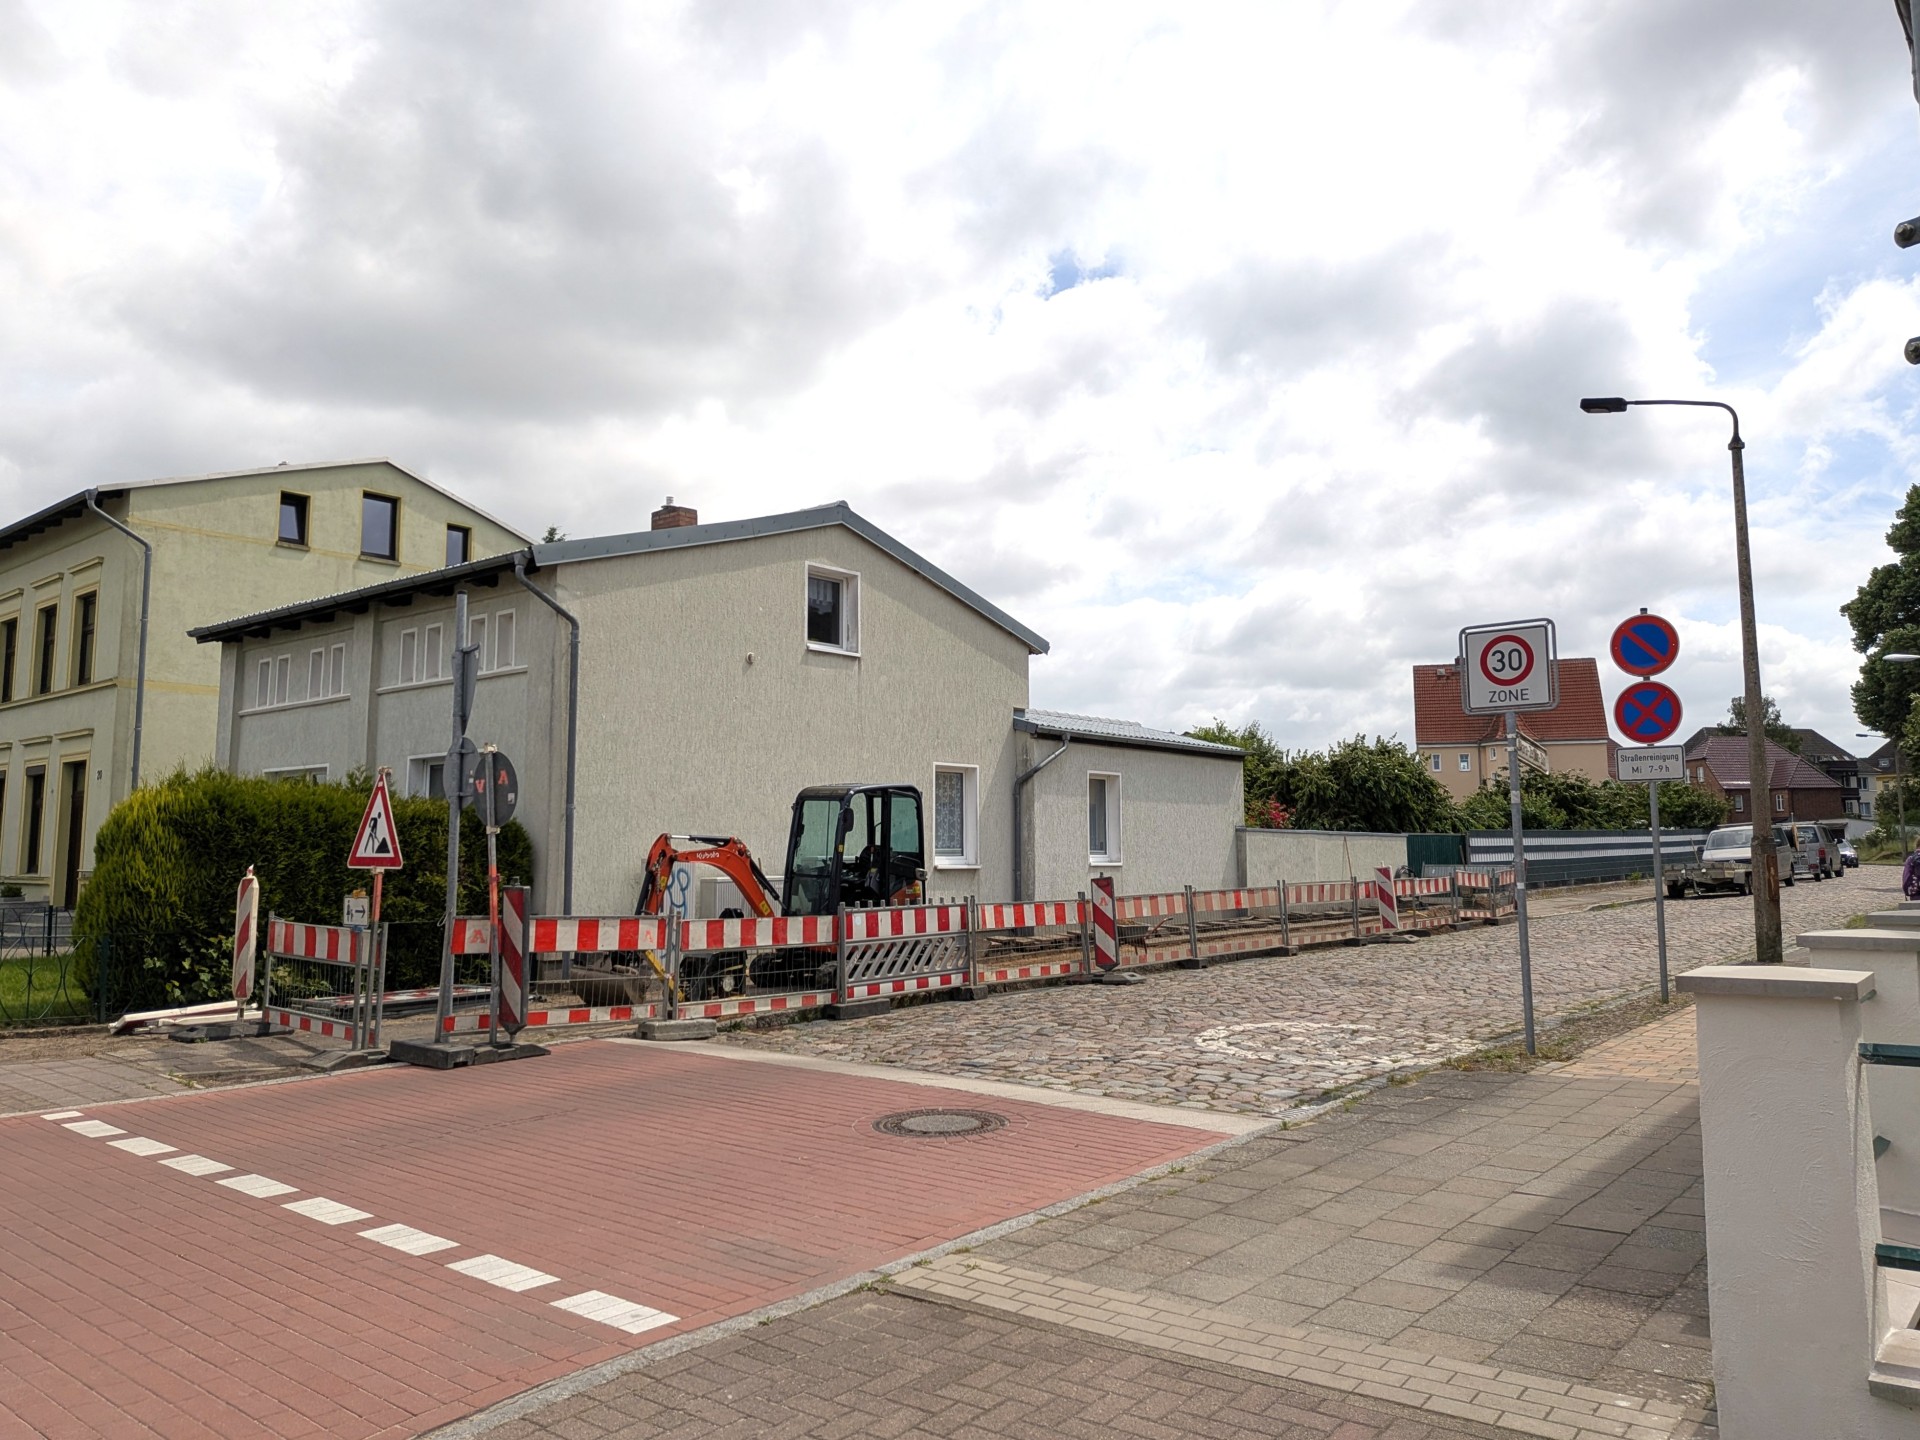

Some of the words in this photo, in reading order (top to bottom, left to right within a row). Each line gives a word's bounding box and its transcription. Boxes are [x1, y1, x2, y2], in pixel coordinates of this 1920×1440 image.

[1491, 648, 1523, 673] 30
[1488, 688, 1530, 703] ZONE
[1620, 753, 1679, 762] Straßenreinigung
[1631, 766, 1642, 774] Mi
[696, 851, 720, 859] Kubota
